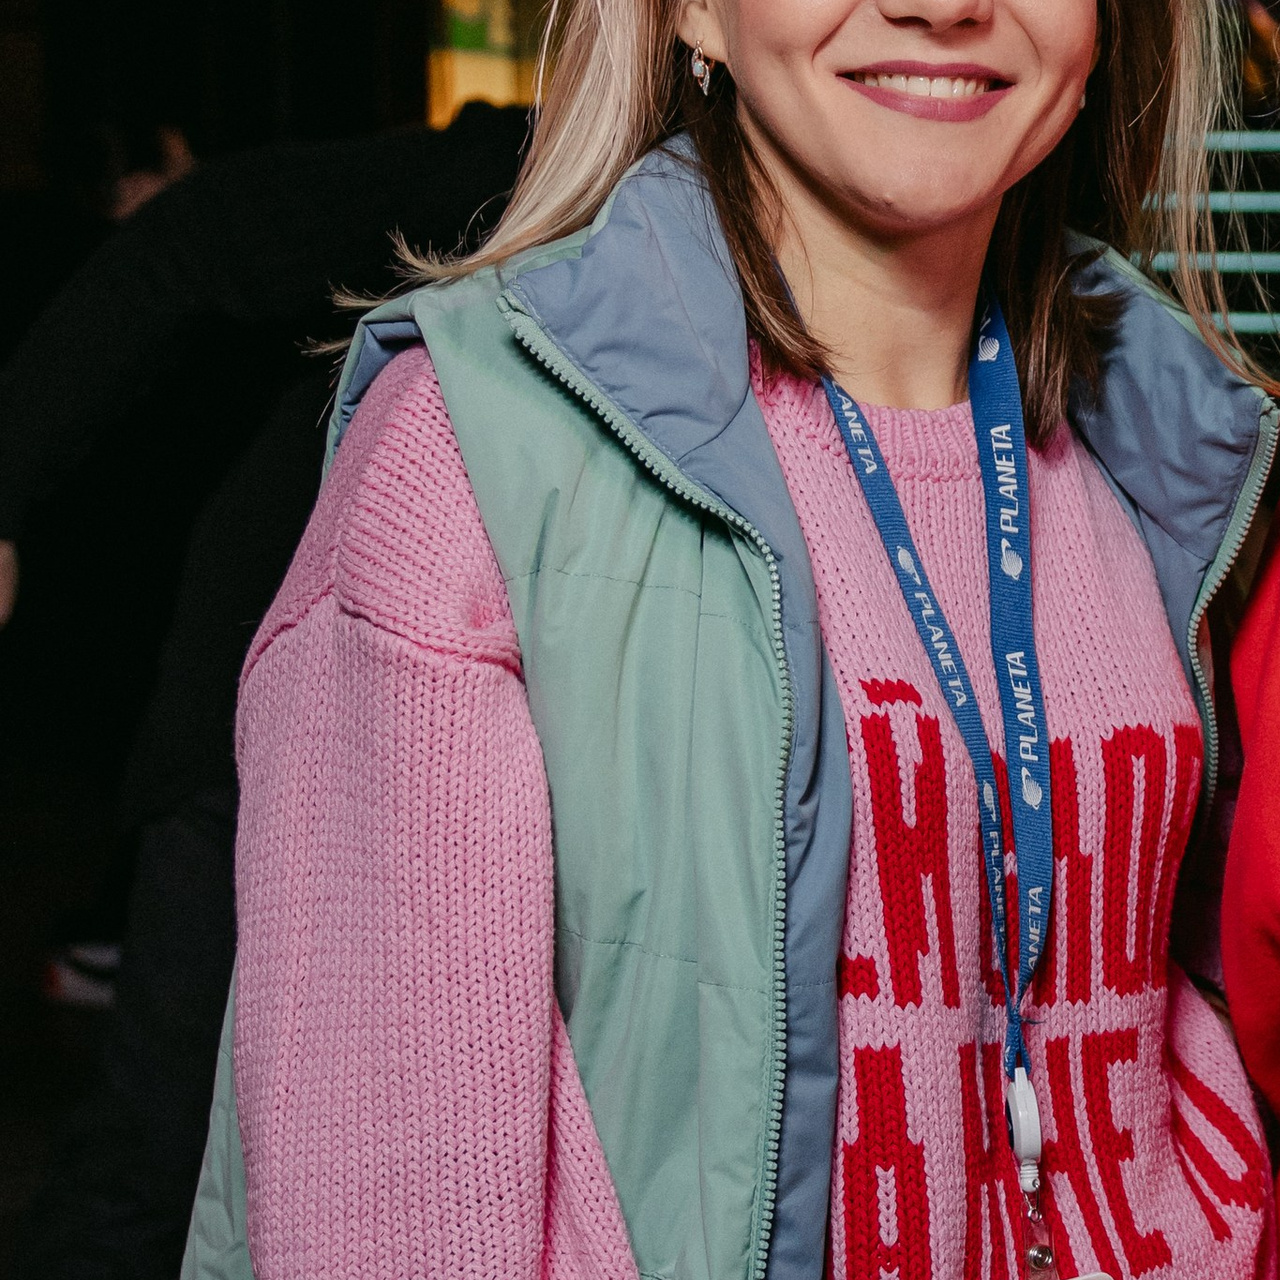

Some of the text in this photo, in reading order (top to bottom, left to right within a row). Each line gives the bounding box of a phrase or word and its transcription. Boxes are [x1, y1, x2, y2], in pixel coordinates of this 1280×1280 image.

[990, 423, 1019, 534] PLANETA
[914, 592, 967, 708] PLANETA
[1005, 650, 1039, 762] PLANETA
[1027, 886, 1043, 970] ANETA
